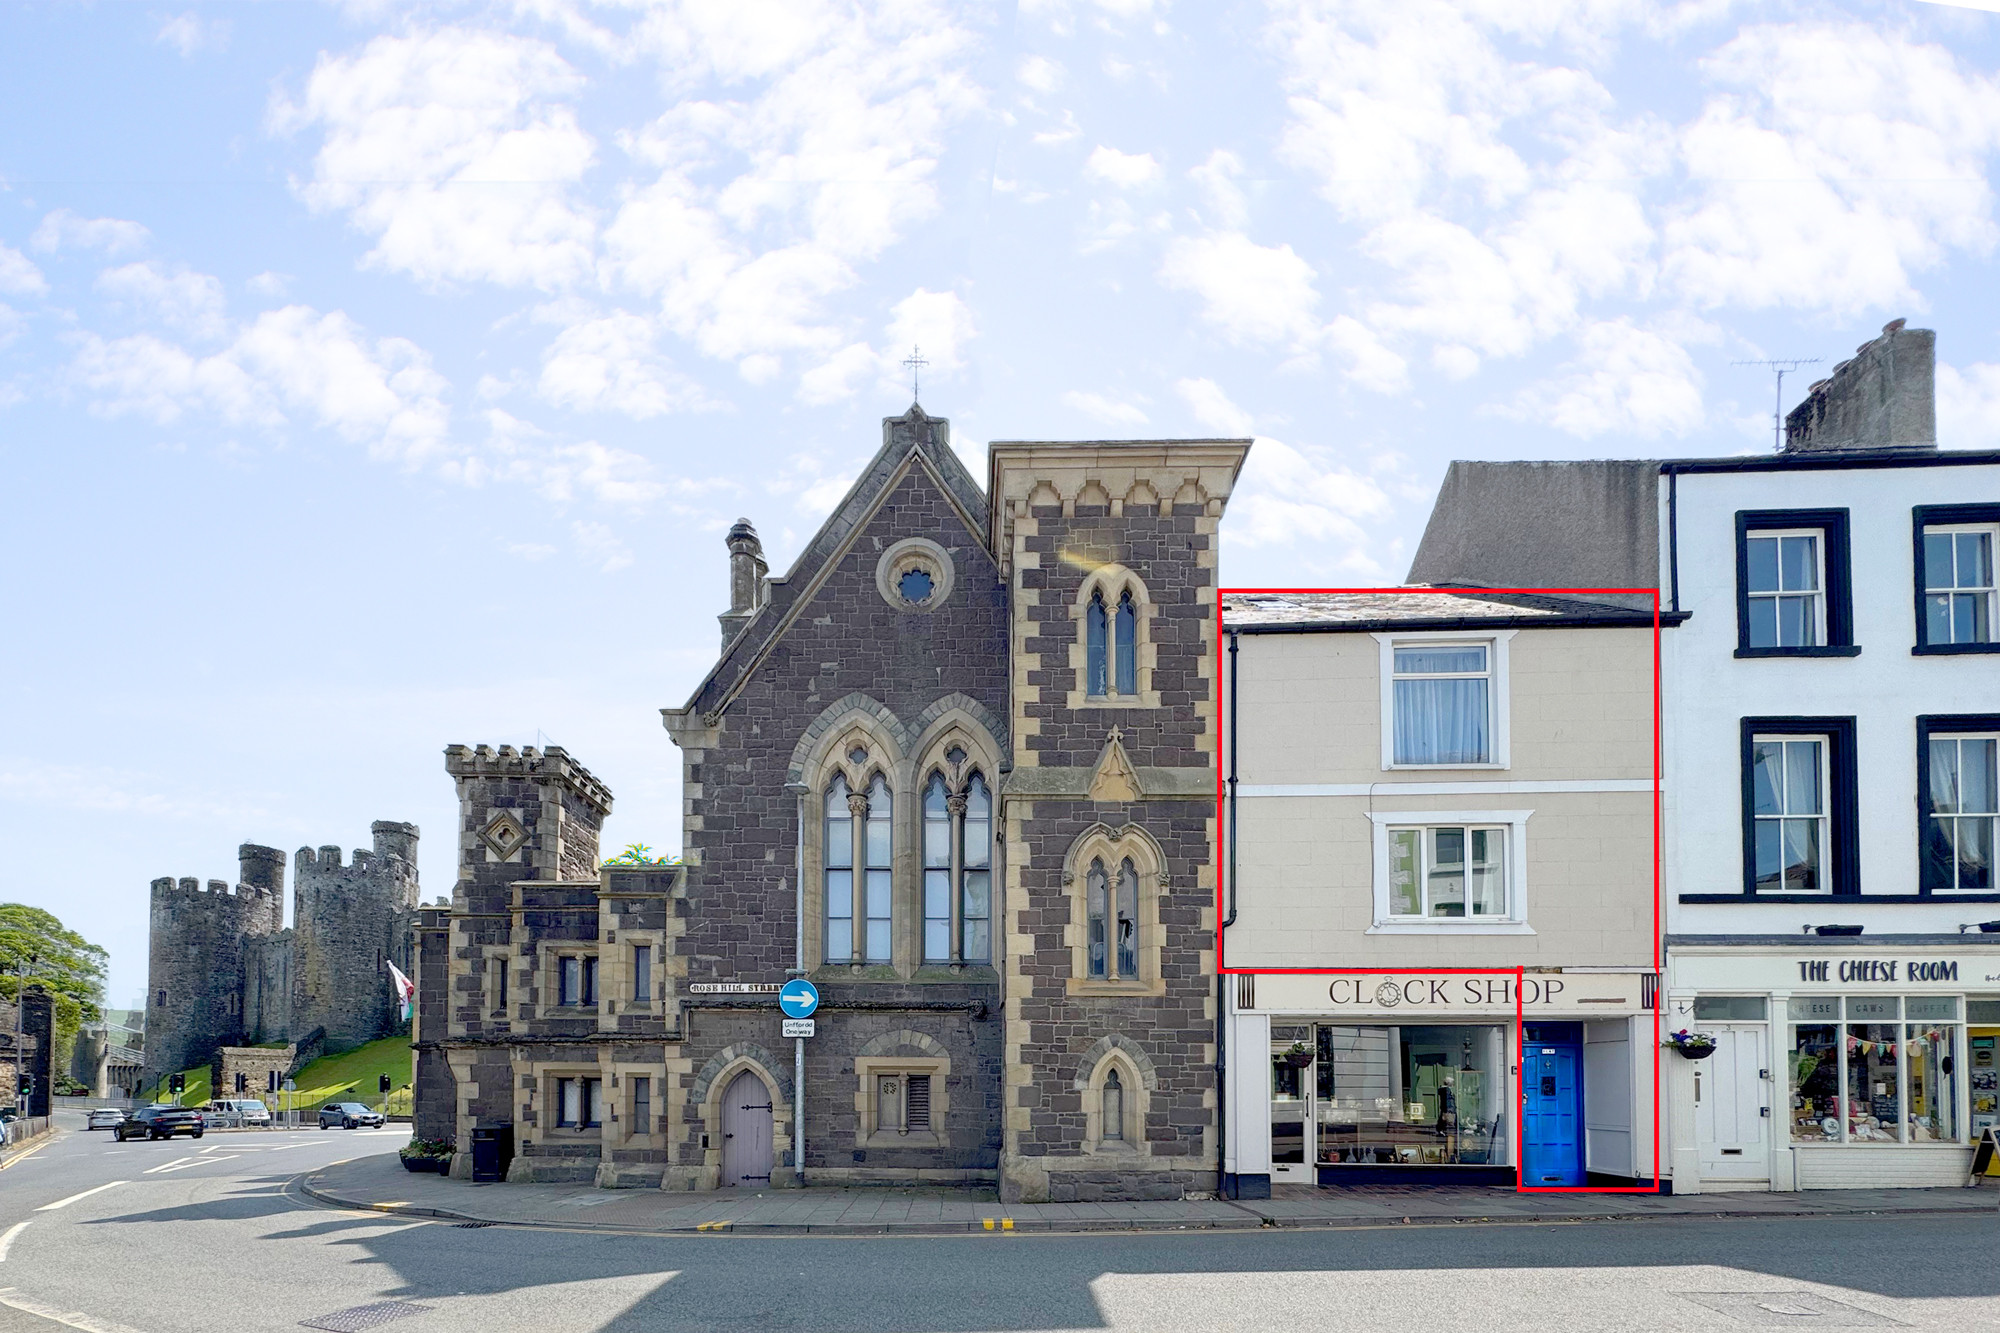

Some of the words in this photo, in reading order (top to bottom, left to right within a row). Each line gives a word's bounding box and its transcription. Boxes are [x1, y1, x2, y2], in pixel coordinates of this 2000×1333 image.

[1797, 960, 1830, 982] THE
[1839, 960, 1899, 983] CHEESE
[1908, 961, 1959, 982] ROOM
[693, 984, 718, 992] ROSE
[721, 984, 745, 992] HILL
[1464, 979, 1564, 1004] SHOP
[1855, 1004, 1884, 1013] CAWS
